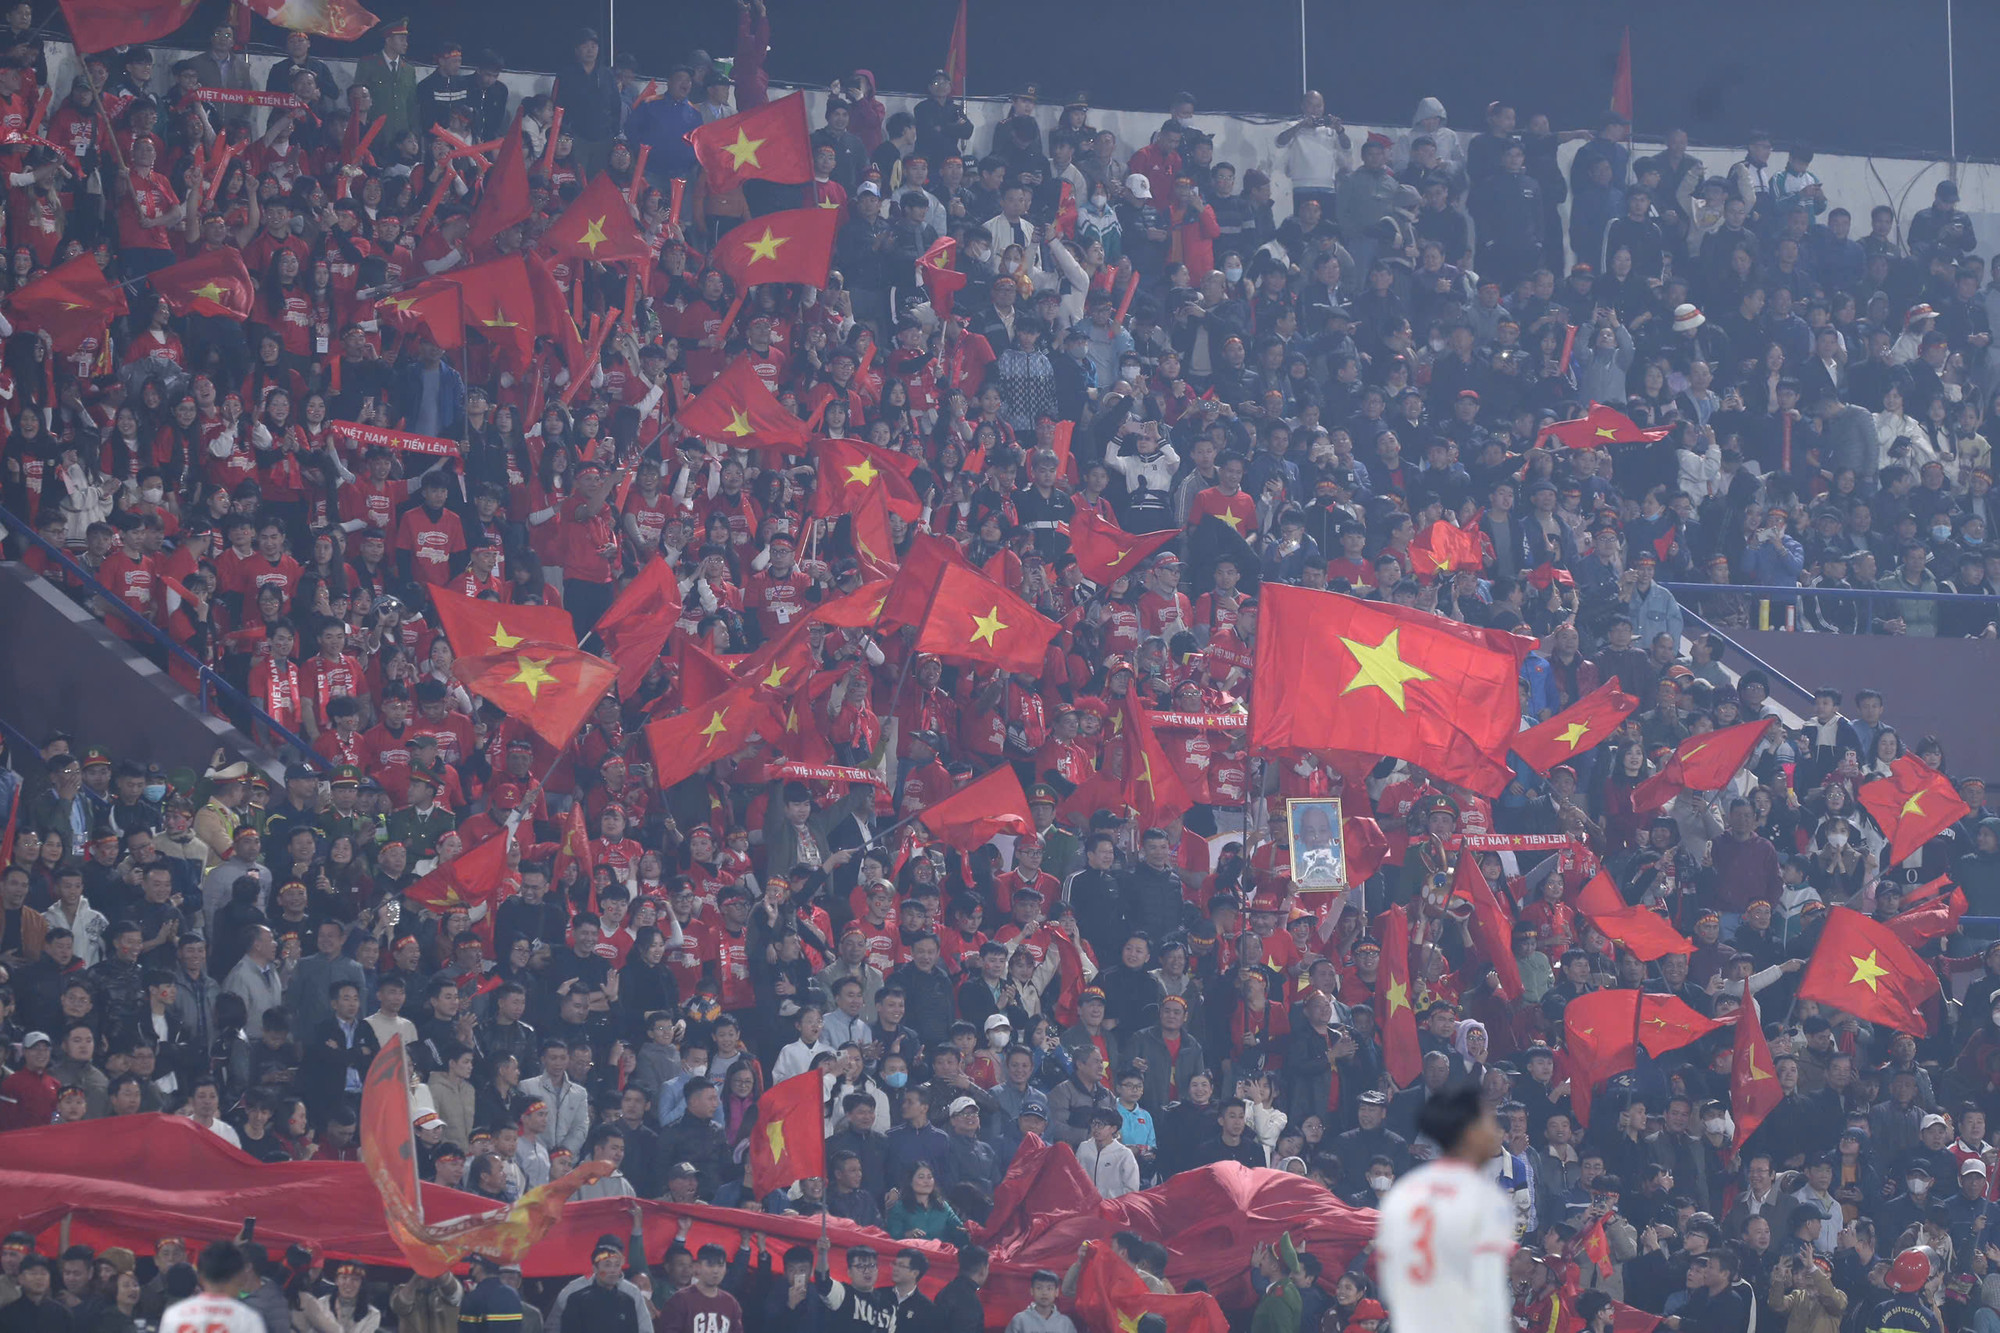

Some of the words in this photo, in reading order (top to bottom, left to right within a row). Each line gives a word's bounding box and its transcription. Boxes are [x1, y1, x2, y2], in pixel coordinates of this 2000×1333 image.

[221, 94, 244, 103] NAM
[340, 427, 363, 440] VIỆT
[364, 431, 388, 445] NAM
[403, 437, 425, 451] TIẾN
[427, 442, 448, 454] LÊN
[1184, 715, 1204, 725] NAM
[815, 768, 836, 777] NAM
[1488, 836, 1510, 845] NAM
[1408, 1205, 1435, 1286] 3
